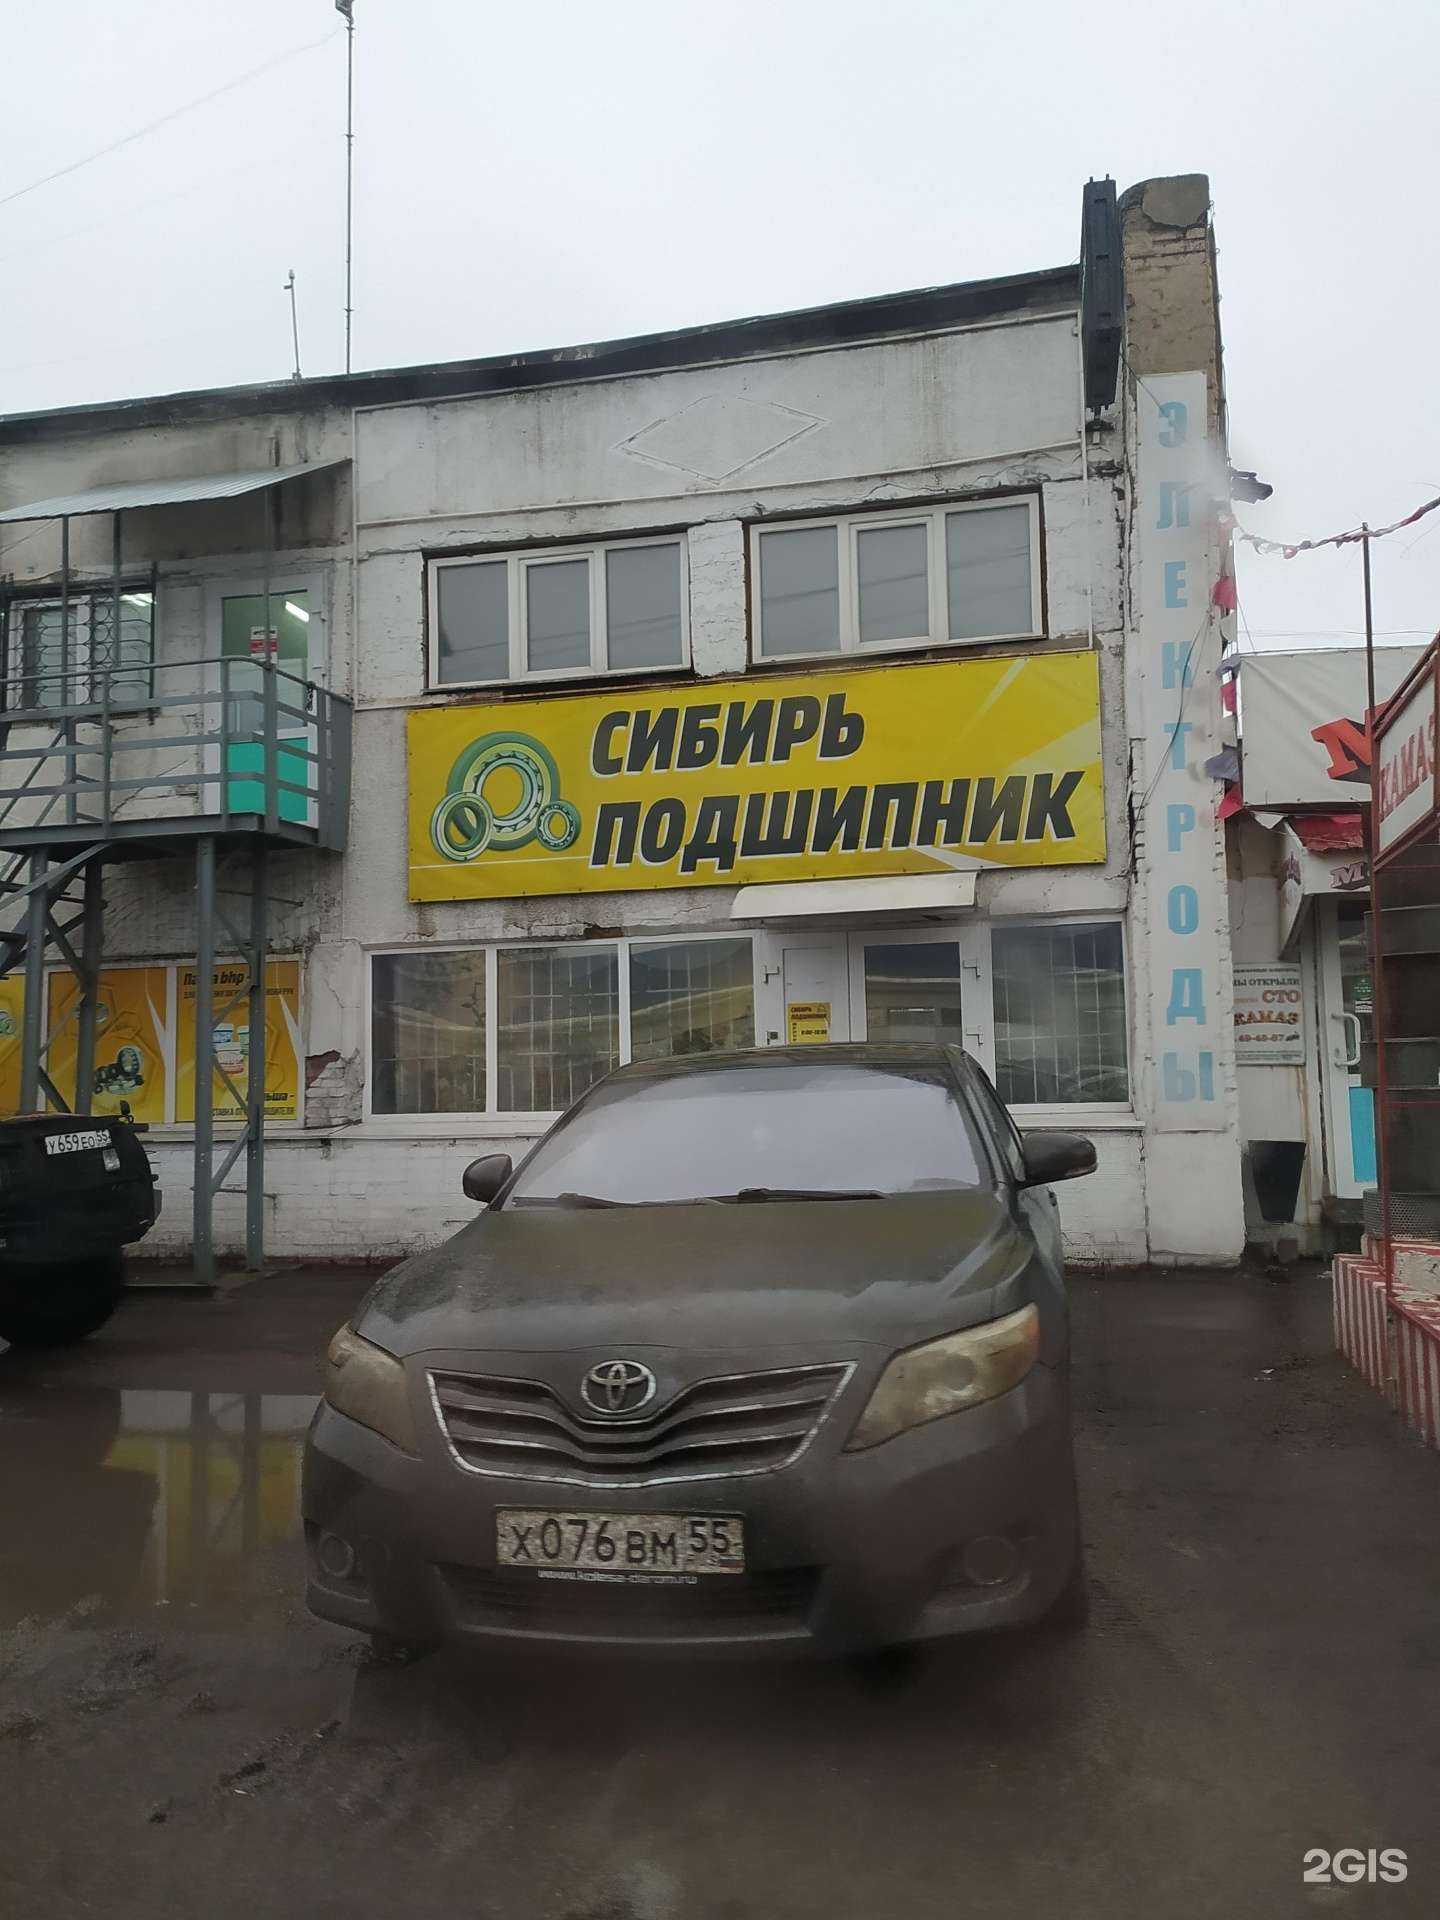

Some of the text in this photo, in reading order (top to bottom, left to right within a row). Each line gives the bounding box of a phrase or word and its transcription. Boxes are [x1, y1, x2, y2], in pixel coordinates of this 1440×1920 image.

[592, 693, 865, 776] СИБИРЬ
[1156, 401, 1214, 1101] ЭЛЕКТРОДЫ
[590, 771, 1086, 873] ПОДШИПНИК
[1262, 989, 1300, 1004] СТО
